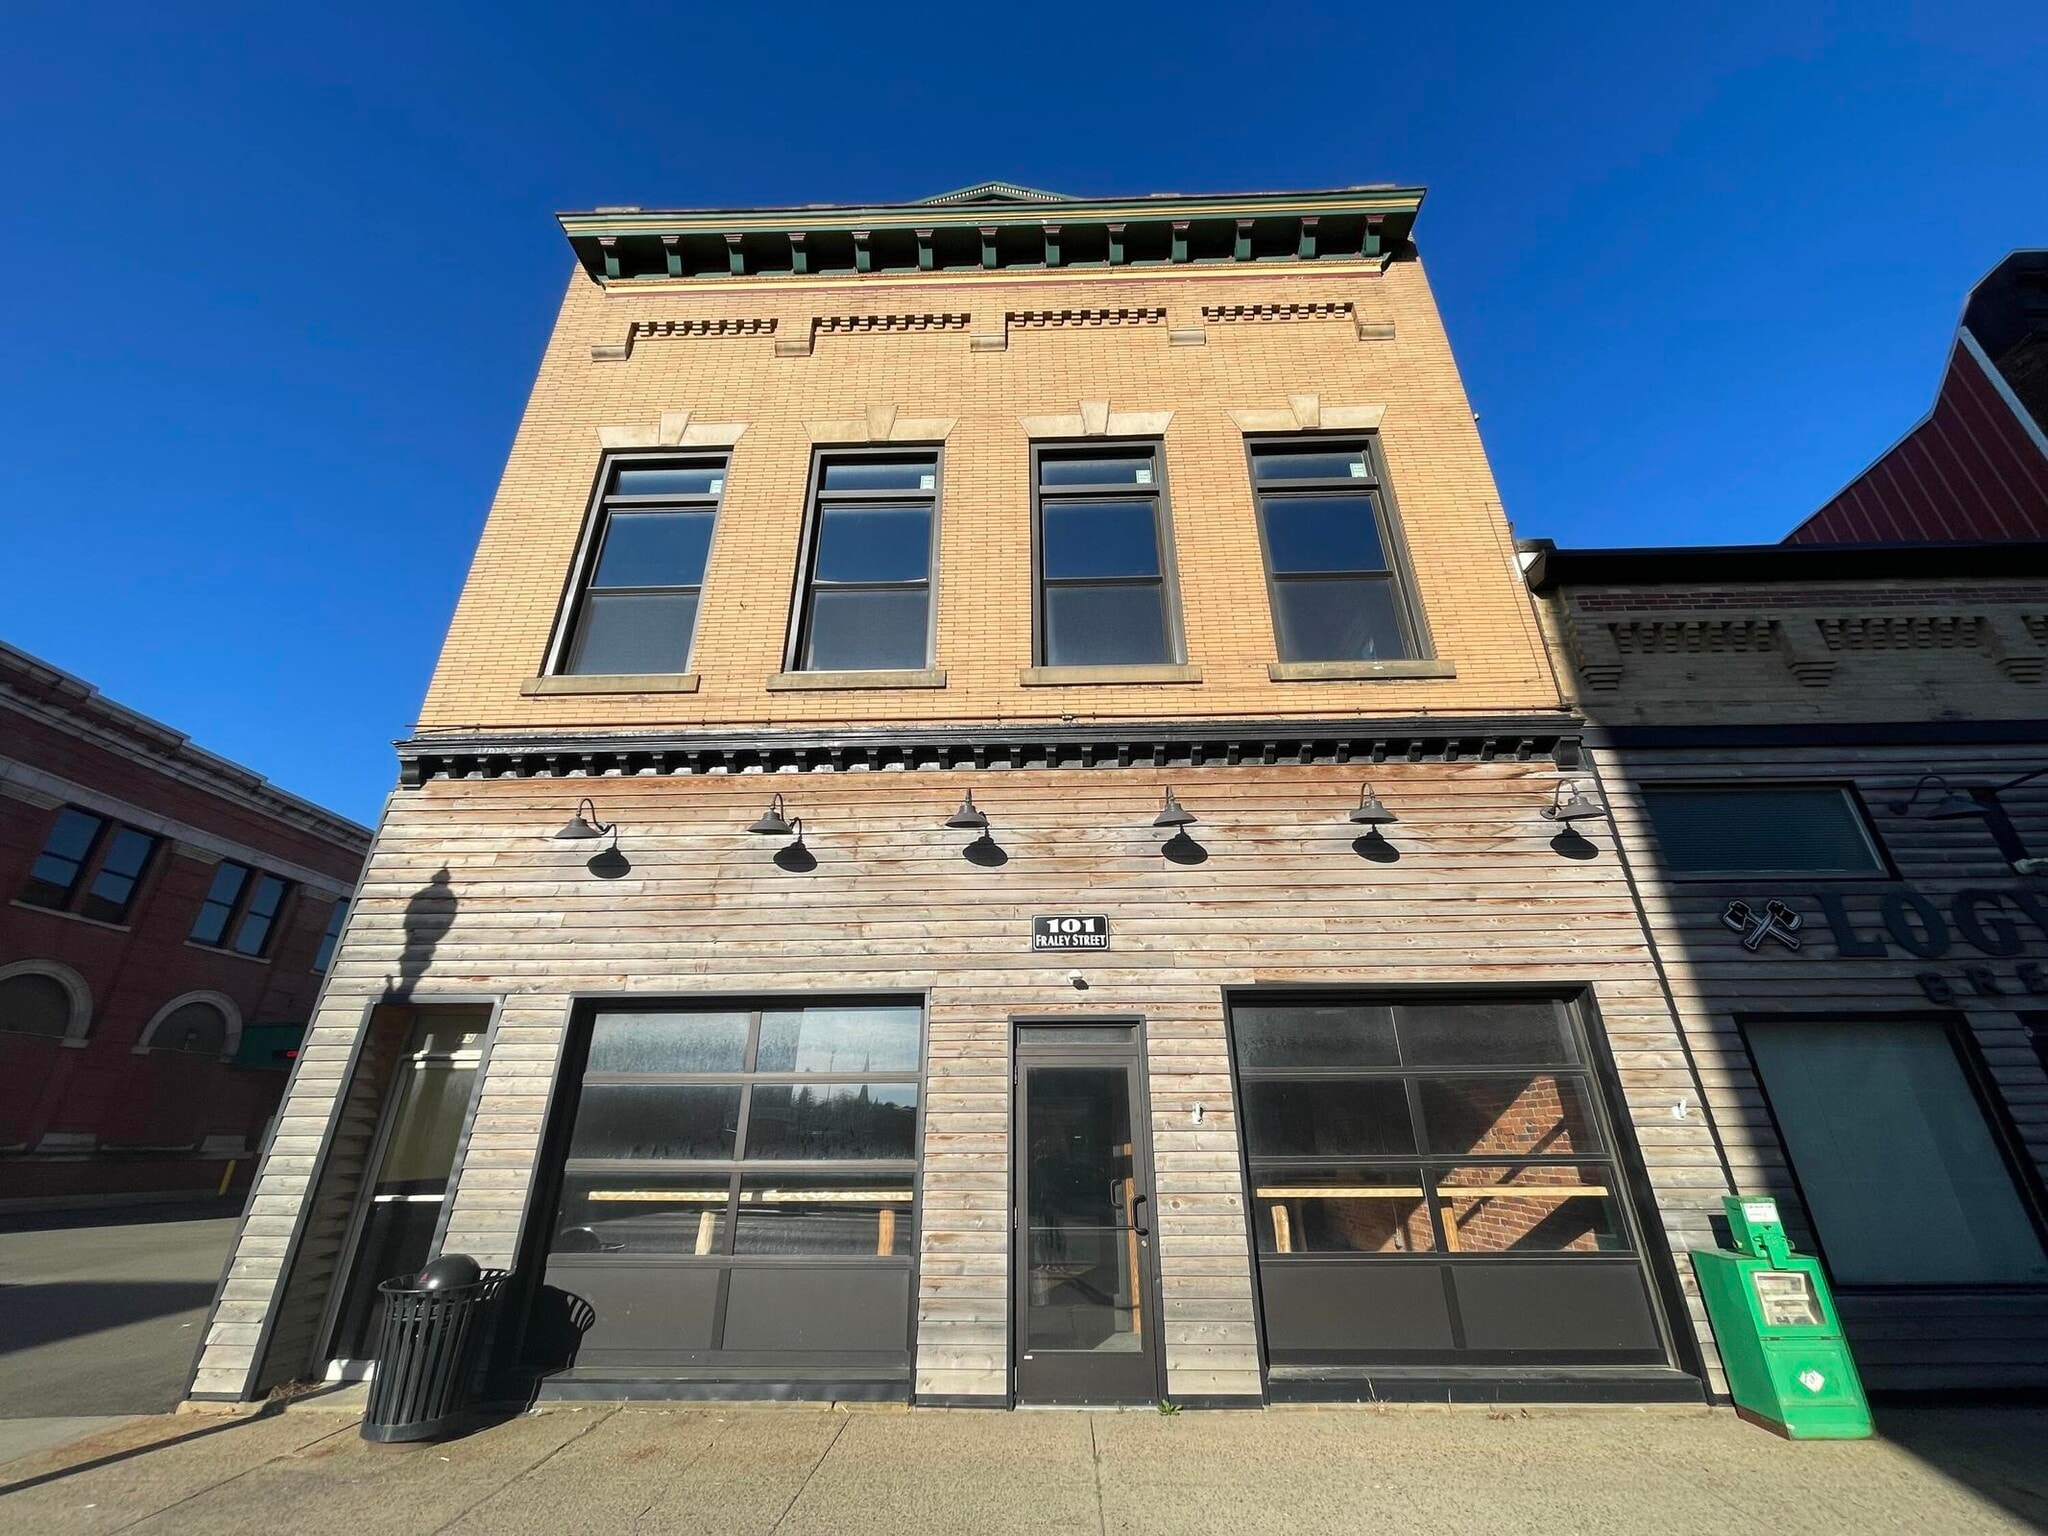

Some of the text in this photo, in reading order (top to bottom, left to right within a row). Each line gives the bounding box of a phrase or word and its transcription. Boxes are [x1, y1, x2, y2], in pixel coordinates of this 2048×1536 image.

[1046, 918, 1095, 933] 101
[1035, 933, 1106, 947] FRALEY STREET
